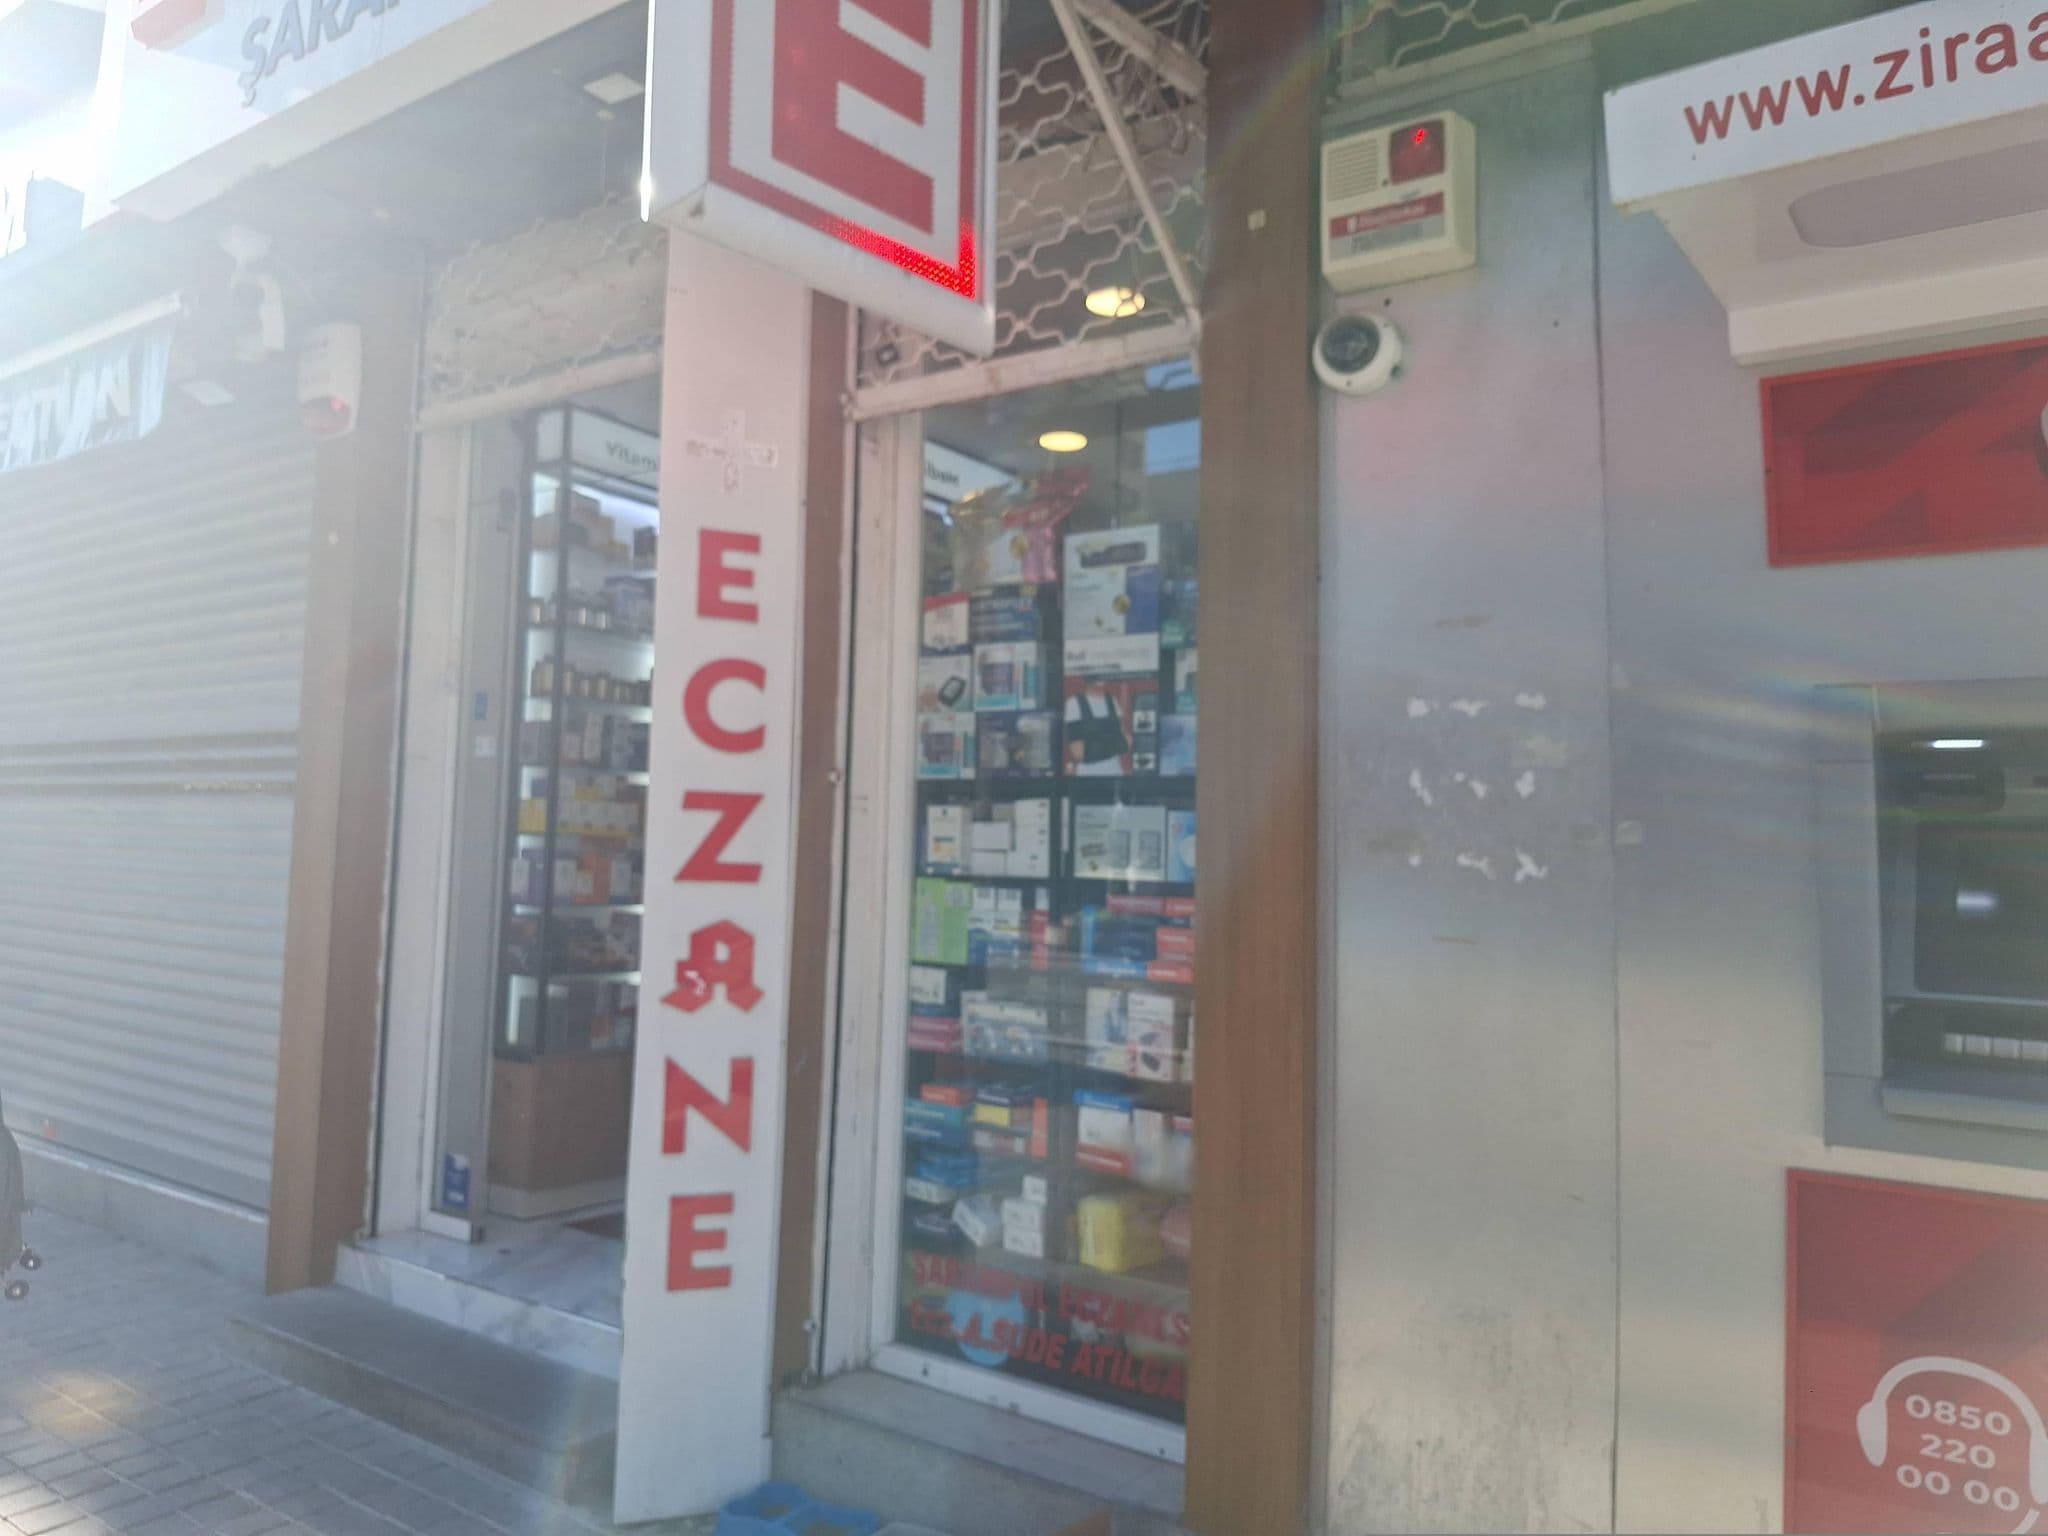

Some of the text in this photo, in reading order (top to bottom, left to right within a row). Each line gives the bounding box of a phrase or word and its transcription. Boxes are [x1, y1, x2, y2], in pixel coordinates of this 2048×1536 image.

[237, 0, 398, 108] ŞAR
[660, 528, 767, 1292] ECZANE
[1905, 1394, 2012, 1436] 0850
[1920, 1433, 1996, 1469] 220
[1896, 1464, 2020, 1511] 00 00
